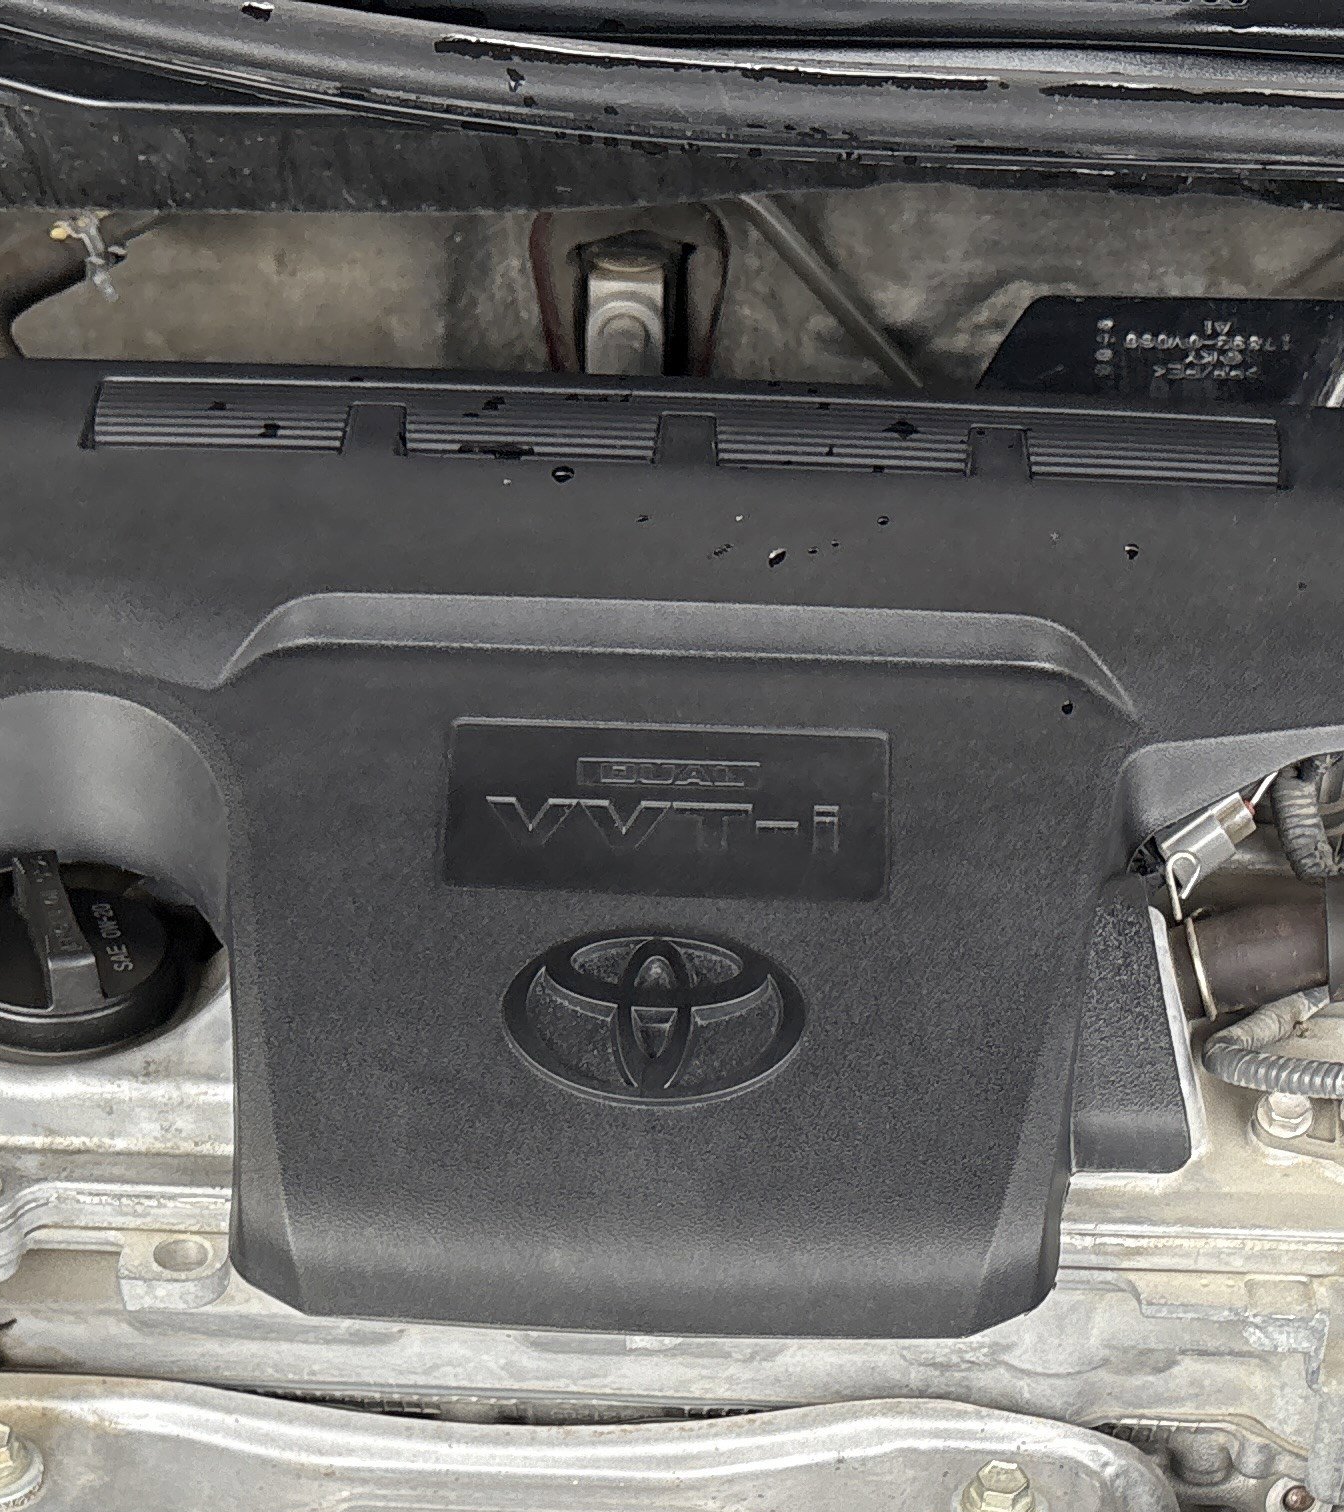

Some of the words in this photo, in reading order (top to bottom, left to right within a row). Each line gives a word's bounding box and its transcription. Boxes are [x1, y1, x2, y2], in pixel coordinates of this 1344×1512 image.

[600, 763, 745, 787] DUAL
[486, 796, 840, 854] VVT-i
[91, 903, 122, 939] 0W-20
[105, 944, 134, 971] SAE
